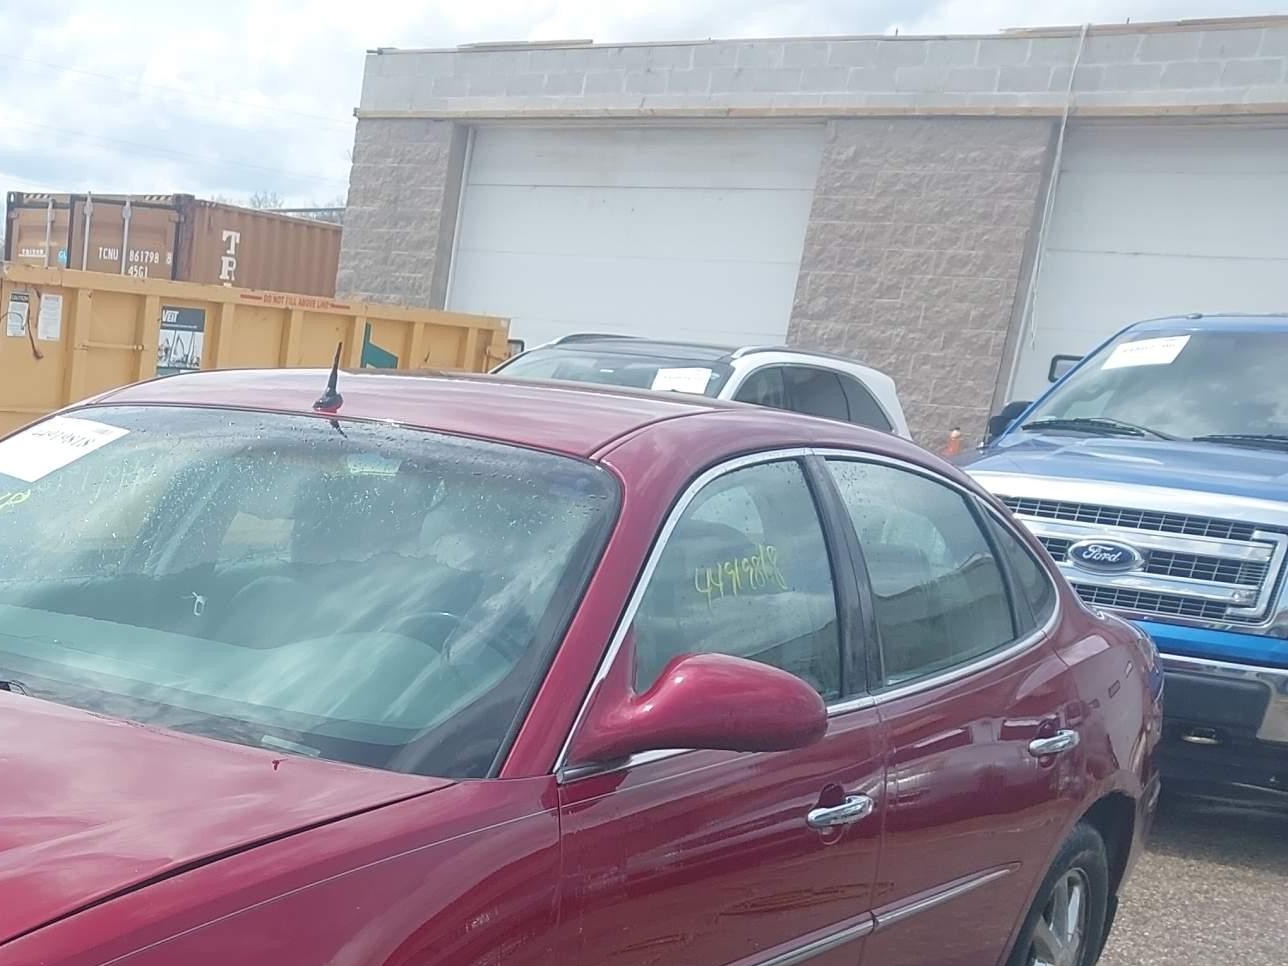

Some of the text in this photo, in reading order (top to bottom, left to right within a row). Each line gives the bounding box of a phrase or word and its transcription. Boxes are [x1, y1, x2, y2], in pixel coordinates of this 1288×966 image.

[98, 247, 119, 260] TCNU
[129, 249, 160, 264] 861798
[219, 230, 241, 288] TR
[128, 264, 149, 279] 45G1
[162, 309, 180, 323] VEIT
[1082, 544, 1123, 563] Ford
